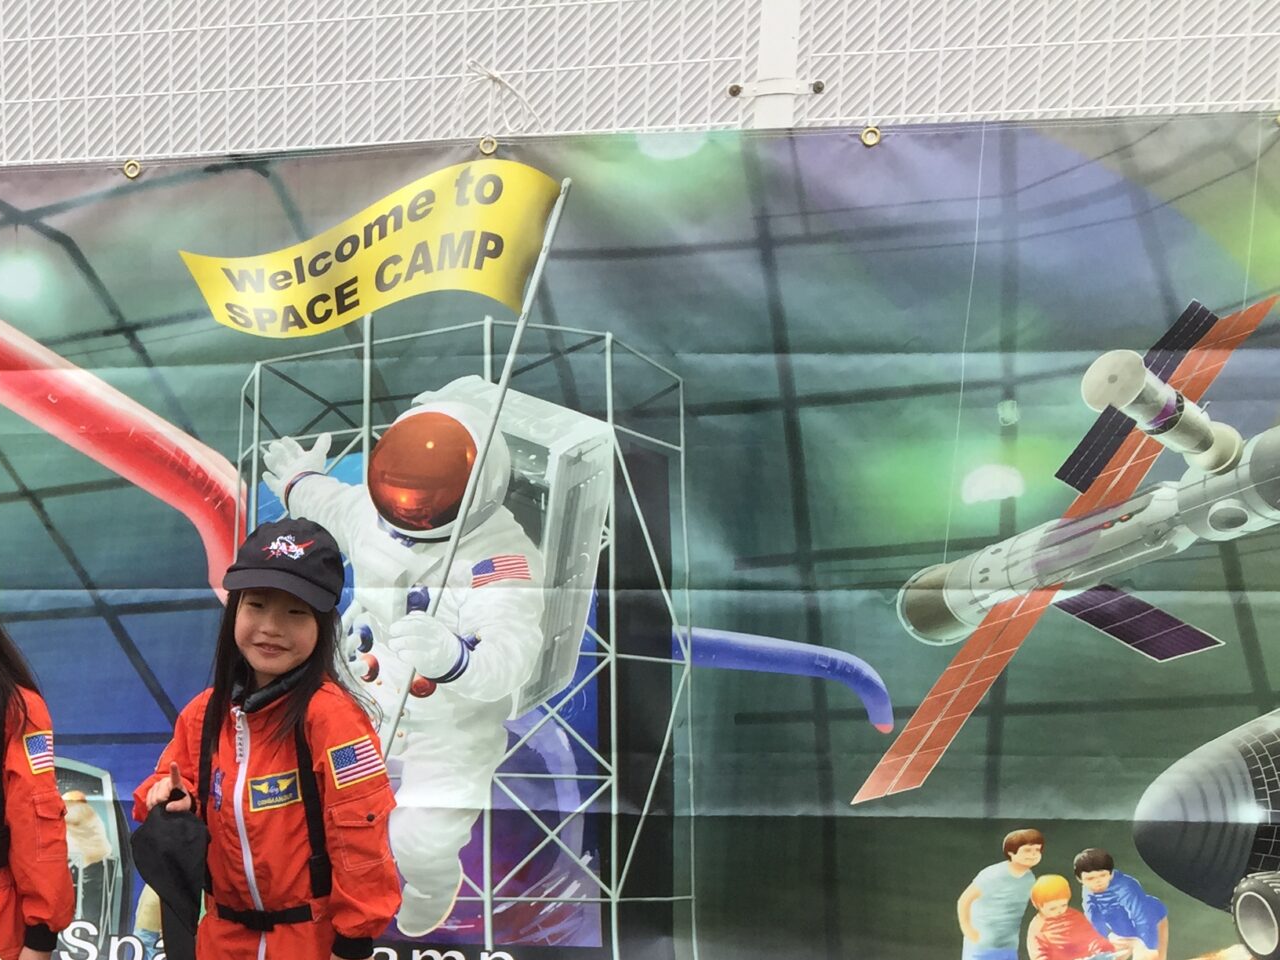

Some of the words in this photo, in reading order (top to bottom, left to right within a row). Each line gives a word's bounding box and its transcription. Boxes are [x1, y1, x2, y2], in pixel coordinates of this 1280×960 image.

[220, 186, 437, 294] Welcome
[454, 166, 505, 206] to
[224, 276, 360, 333] SPACE
[374, 230, 505, 292] CAMP
